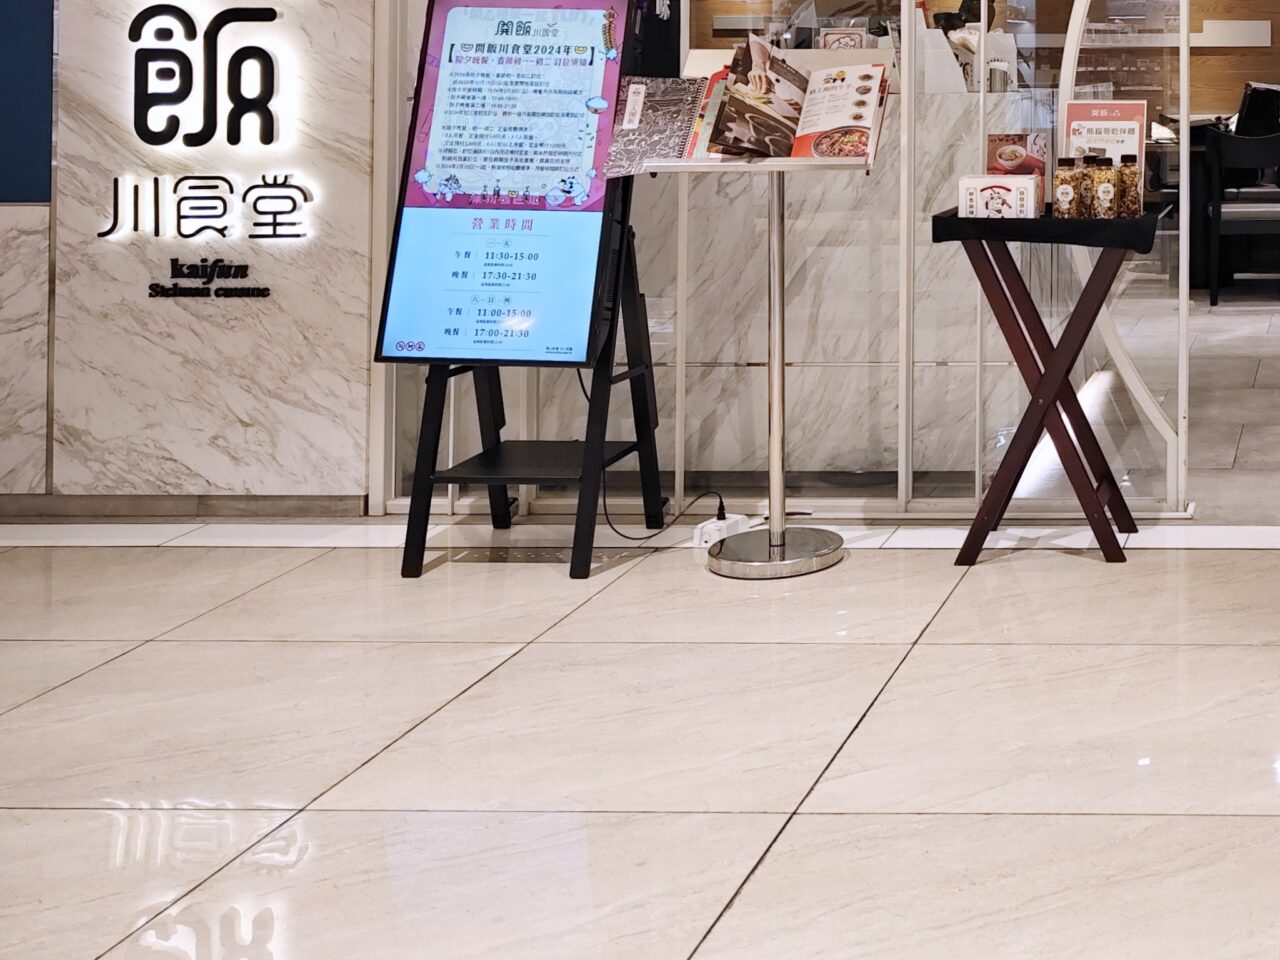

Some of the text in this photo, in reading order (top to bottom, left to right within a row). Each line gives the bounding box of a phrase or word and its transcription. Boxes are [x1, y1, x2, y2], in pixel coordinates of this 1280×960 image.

[97, 174, 313, 239] 川食堂
[472, 217, 534, 231] 營業時間
[484, 251, 539, 261] 11:30-15:00
[169, 258, 249, 286] kaifun
[481, 271, 537, 281] 17:30-21:30
